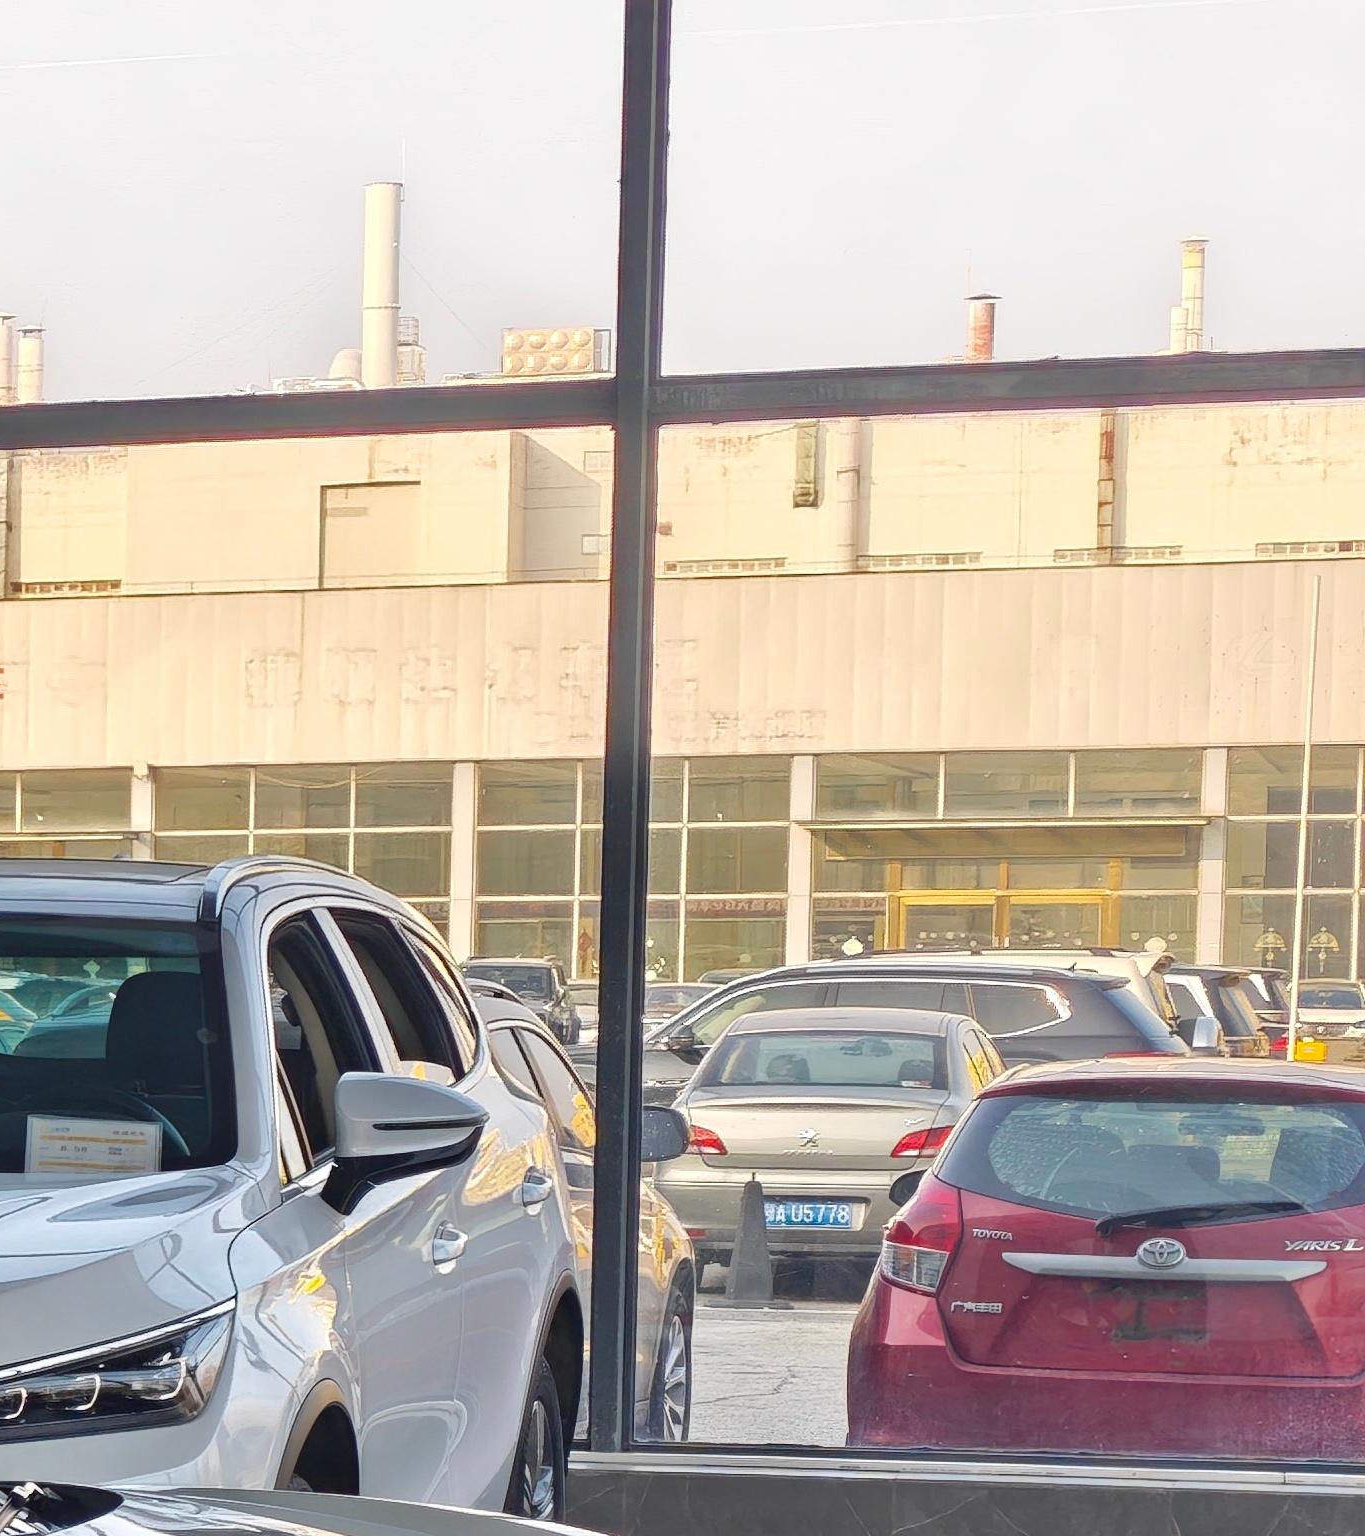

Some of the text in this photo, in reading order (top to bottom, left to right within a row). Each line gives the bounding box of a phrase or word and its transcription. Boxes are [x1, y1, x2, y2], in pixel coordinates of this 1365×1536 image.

[972, 1228, 1013, 1241] TOYOTA
[1284, 1238, 1365, 1252] YARIS L
